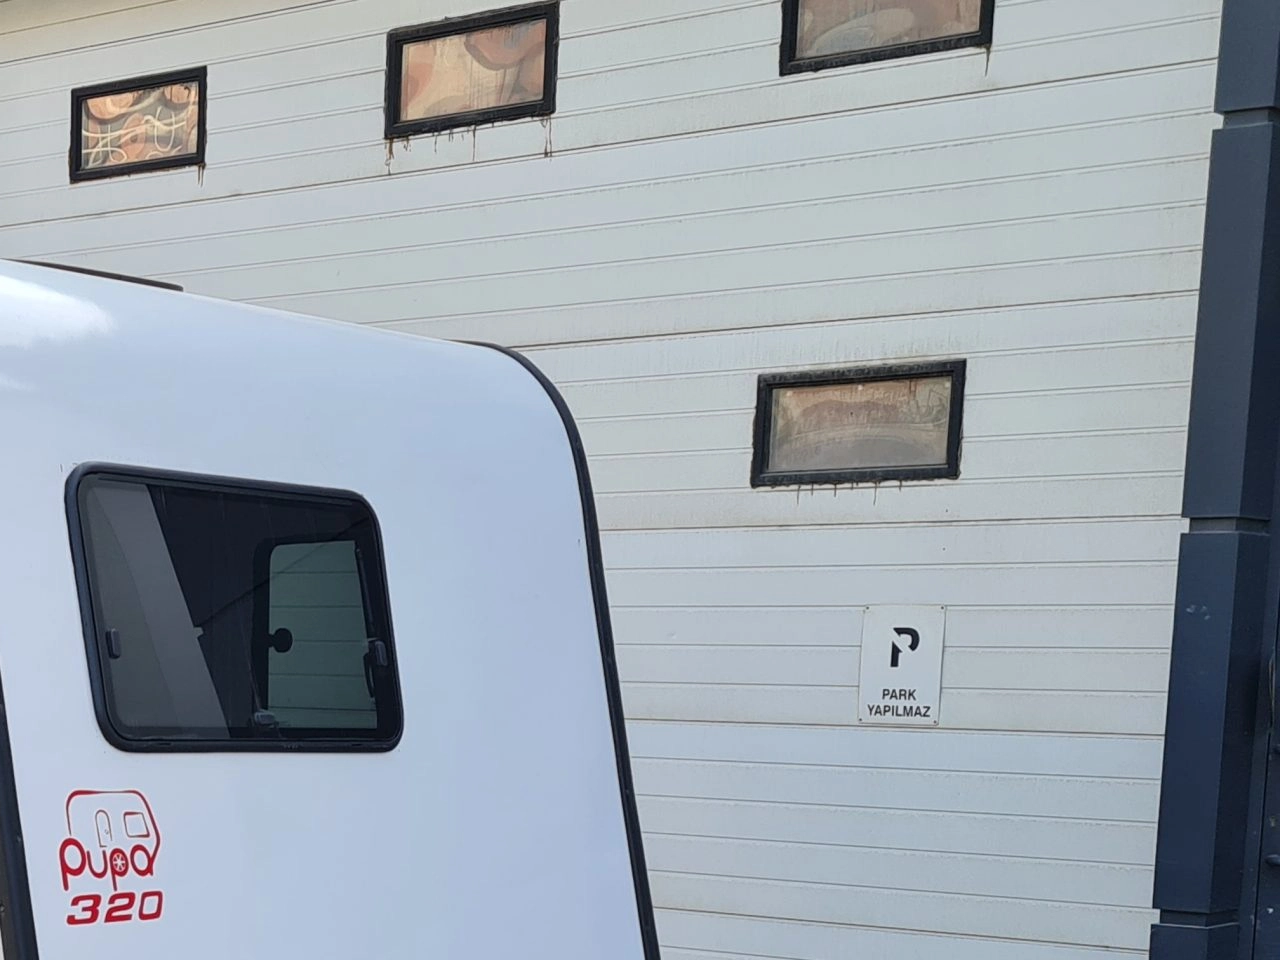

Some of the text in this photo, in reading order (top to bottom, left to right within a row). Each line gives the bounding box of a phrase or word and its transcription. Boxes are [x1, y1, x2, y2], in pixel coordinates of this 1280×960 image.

[882, 688, 917, 701] PARK
[867, 703, 931, 718] YAPILMAZ
[58, 837, 155, 892] pupa
[66, 890, 165, 926] 320
